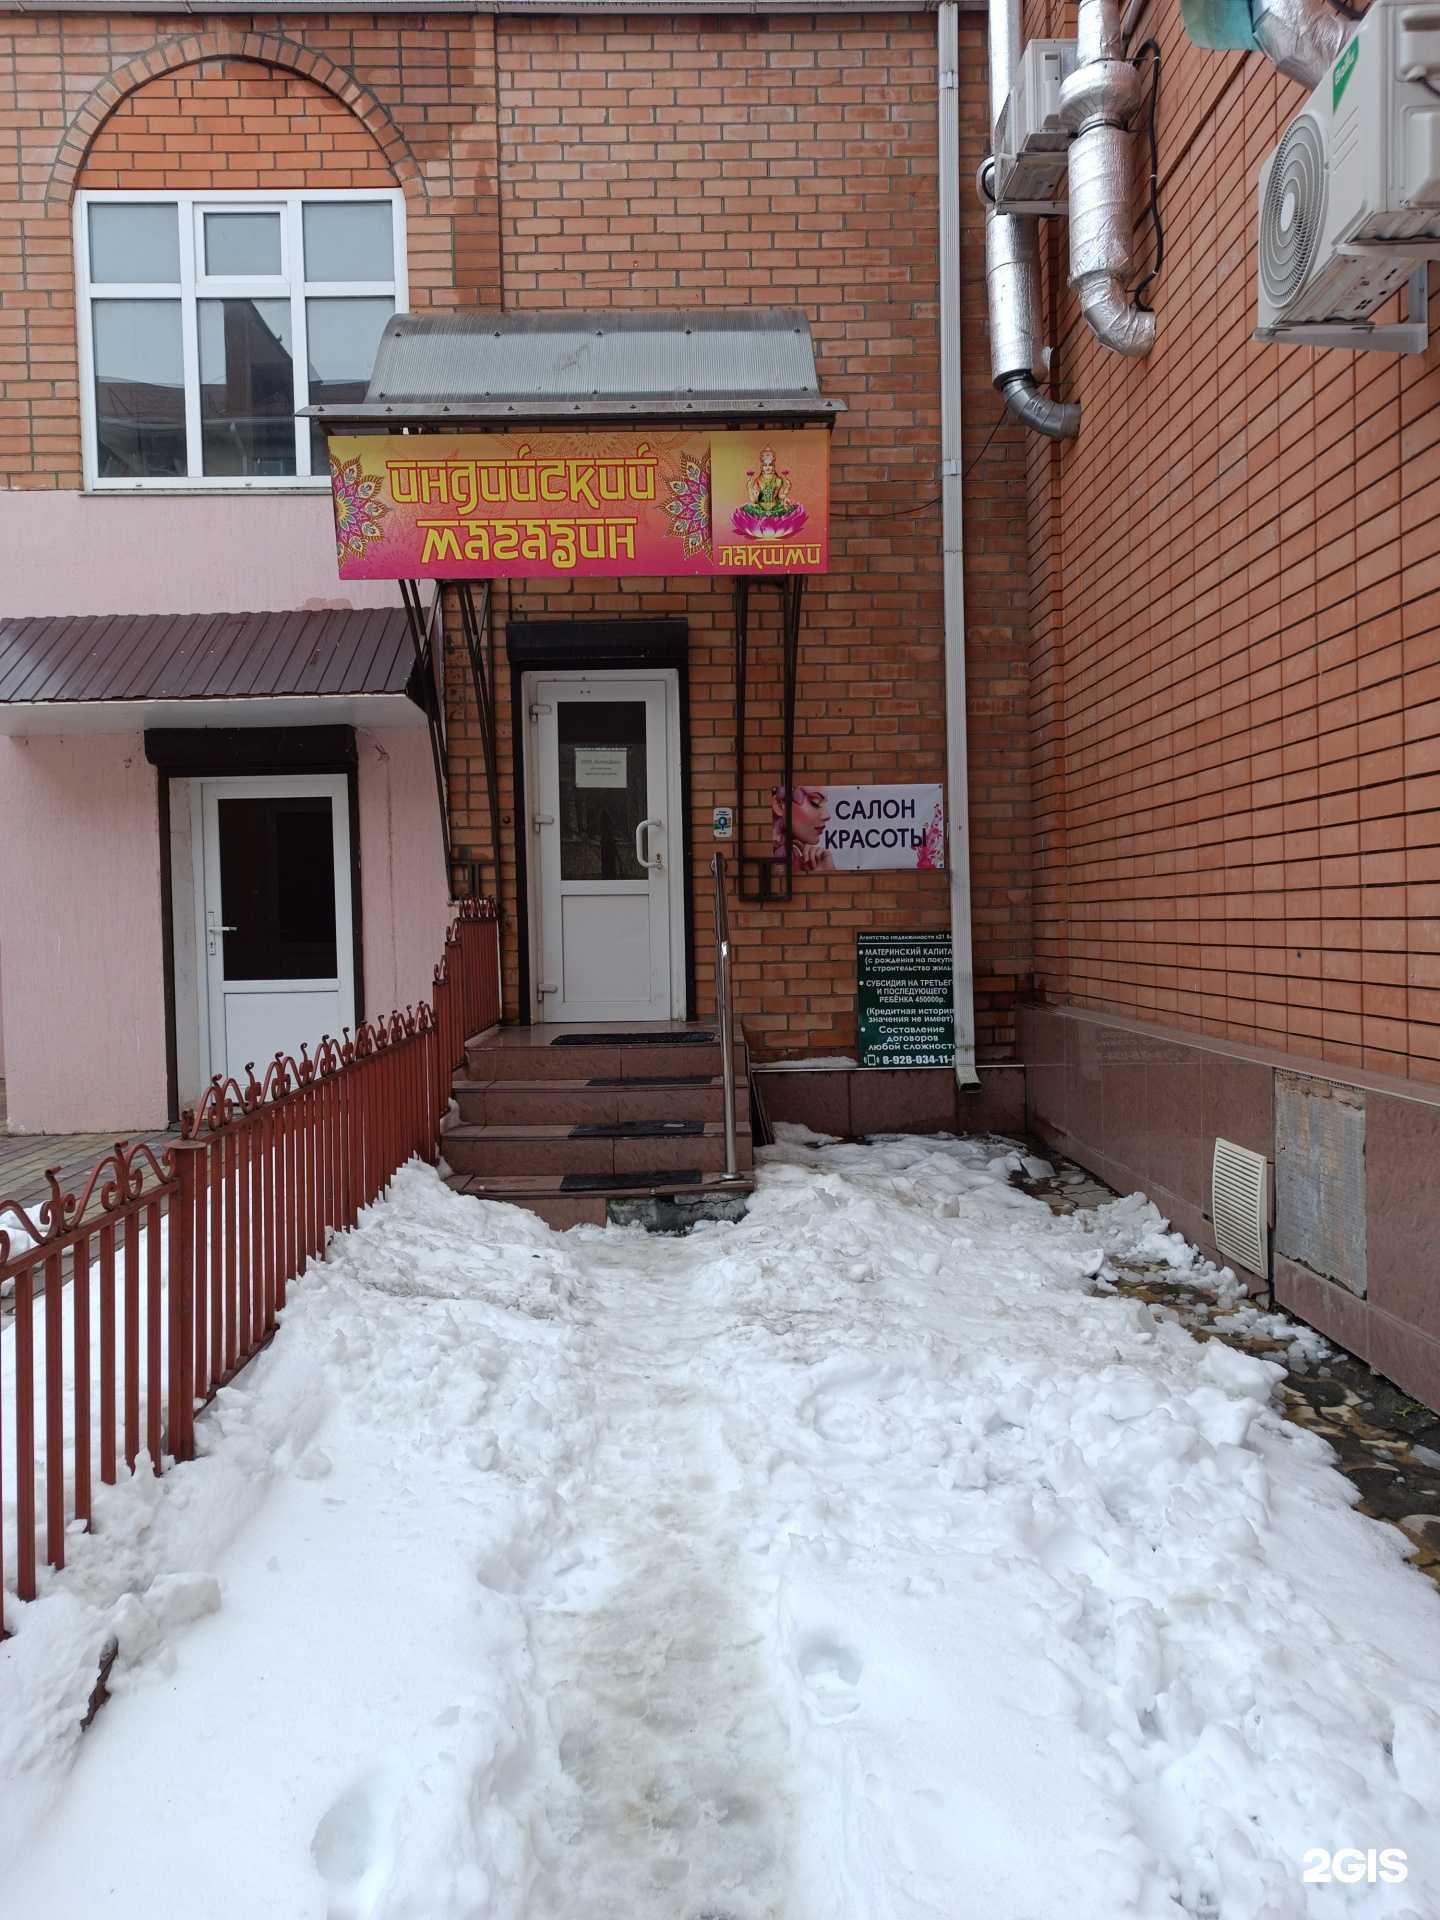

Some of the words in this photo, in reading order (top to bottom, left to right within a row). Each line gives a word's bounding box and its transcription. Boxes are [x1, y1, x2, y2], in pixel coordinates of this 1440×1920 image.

[835, 799, 915, 820] САЛОН
[825, 828, 927, 849] КРАСОТЫ
[865, 947, 920, 956] МАТЕРИНСКИЙ
[884, 988, 948, 996] ПОСЛЕДУЮЩЕГО
[866, 1008, 916, 1016] (Кредитная
[879, 1026, 945, 1034] Составление
[887, 1035, 939, 1043] договоров
[868, 1042, 901, 1051] любой
